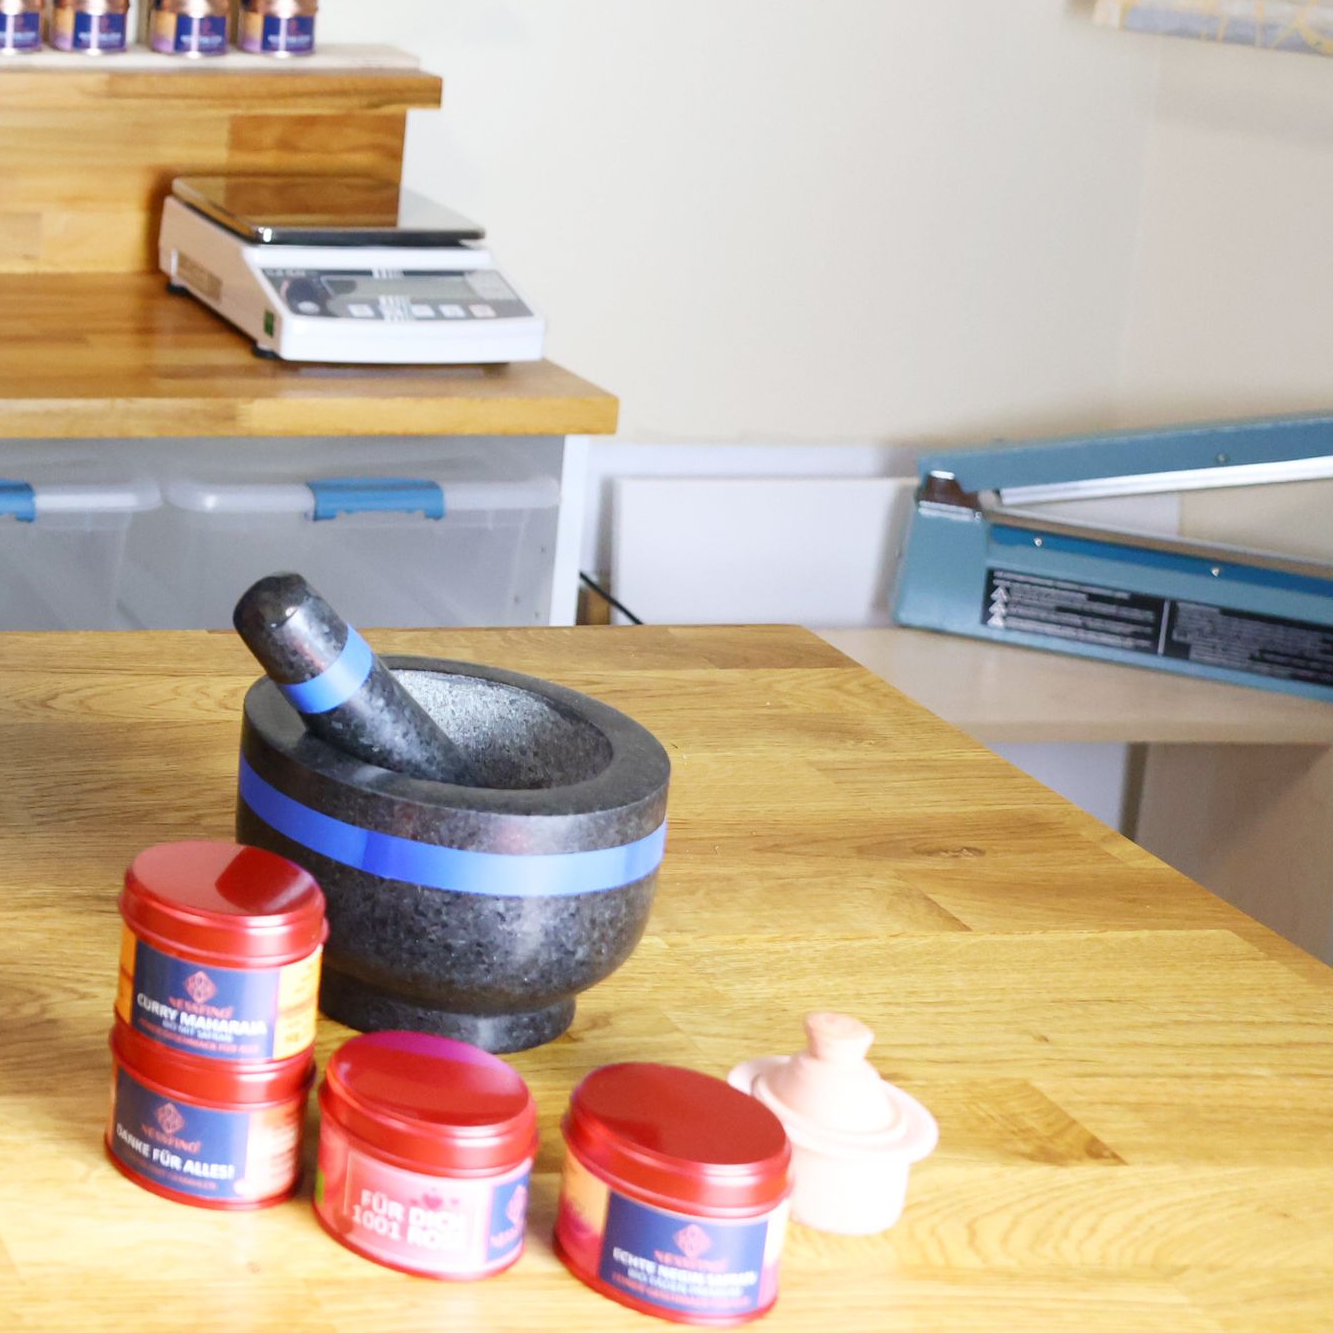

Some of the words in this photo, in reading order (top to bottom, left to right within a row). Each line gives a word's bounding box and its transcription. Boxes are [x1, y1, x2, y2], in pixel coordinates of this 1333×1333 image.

[137, 993, 179, 1021] CURRY
[180, 1011, 267, 1036] MAHARAJA
[116, 1123, 151, 1158] DANKE
[152, 1147, 183, 1172] FÜR
[183, 1159, 236, 1181] ALLES!
[353, 1205, 402, 1242] 1001
[361, 1188, 406, 1223] FÜR
[613, 1247, 656, 1275] ECHTE
